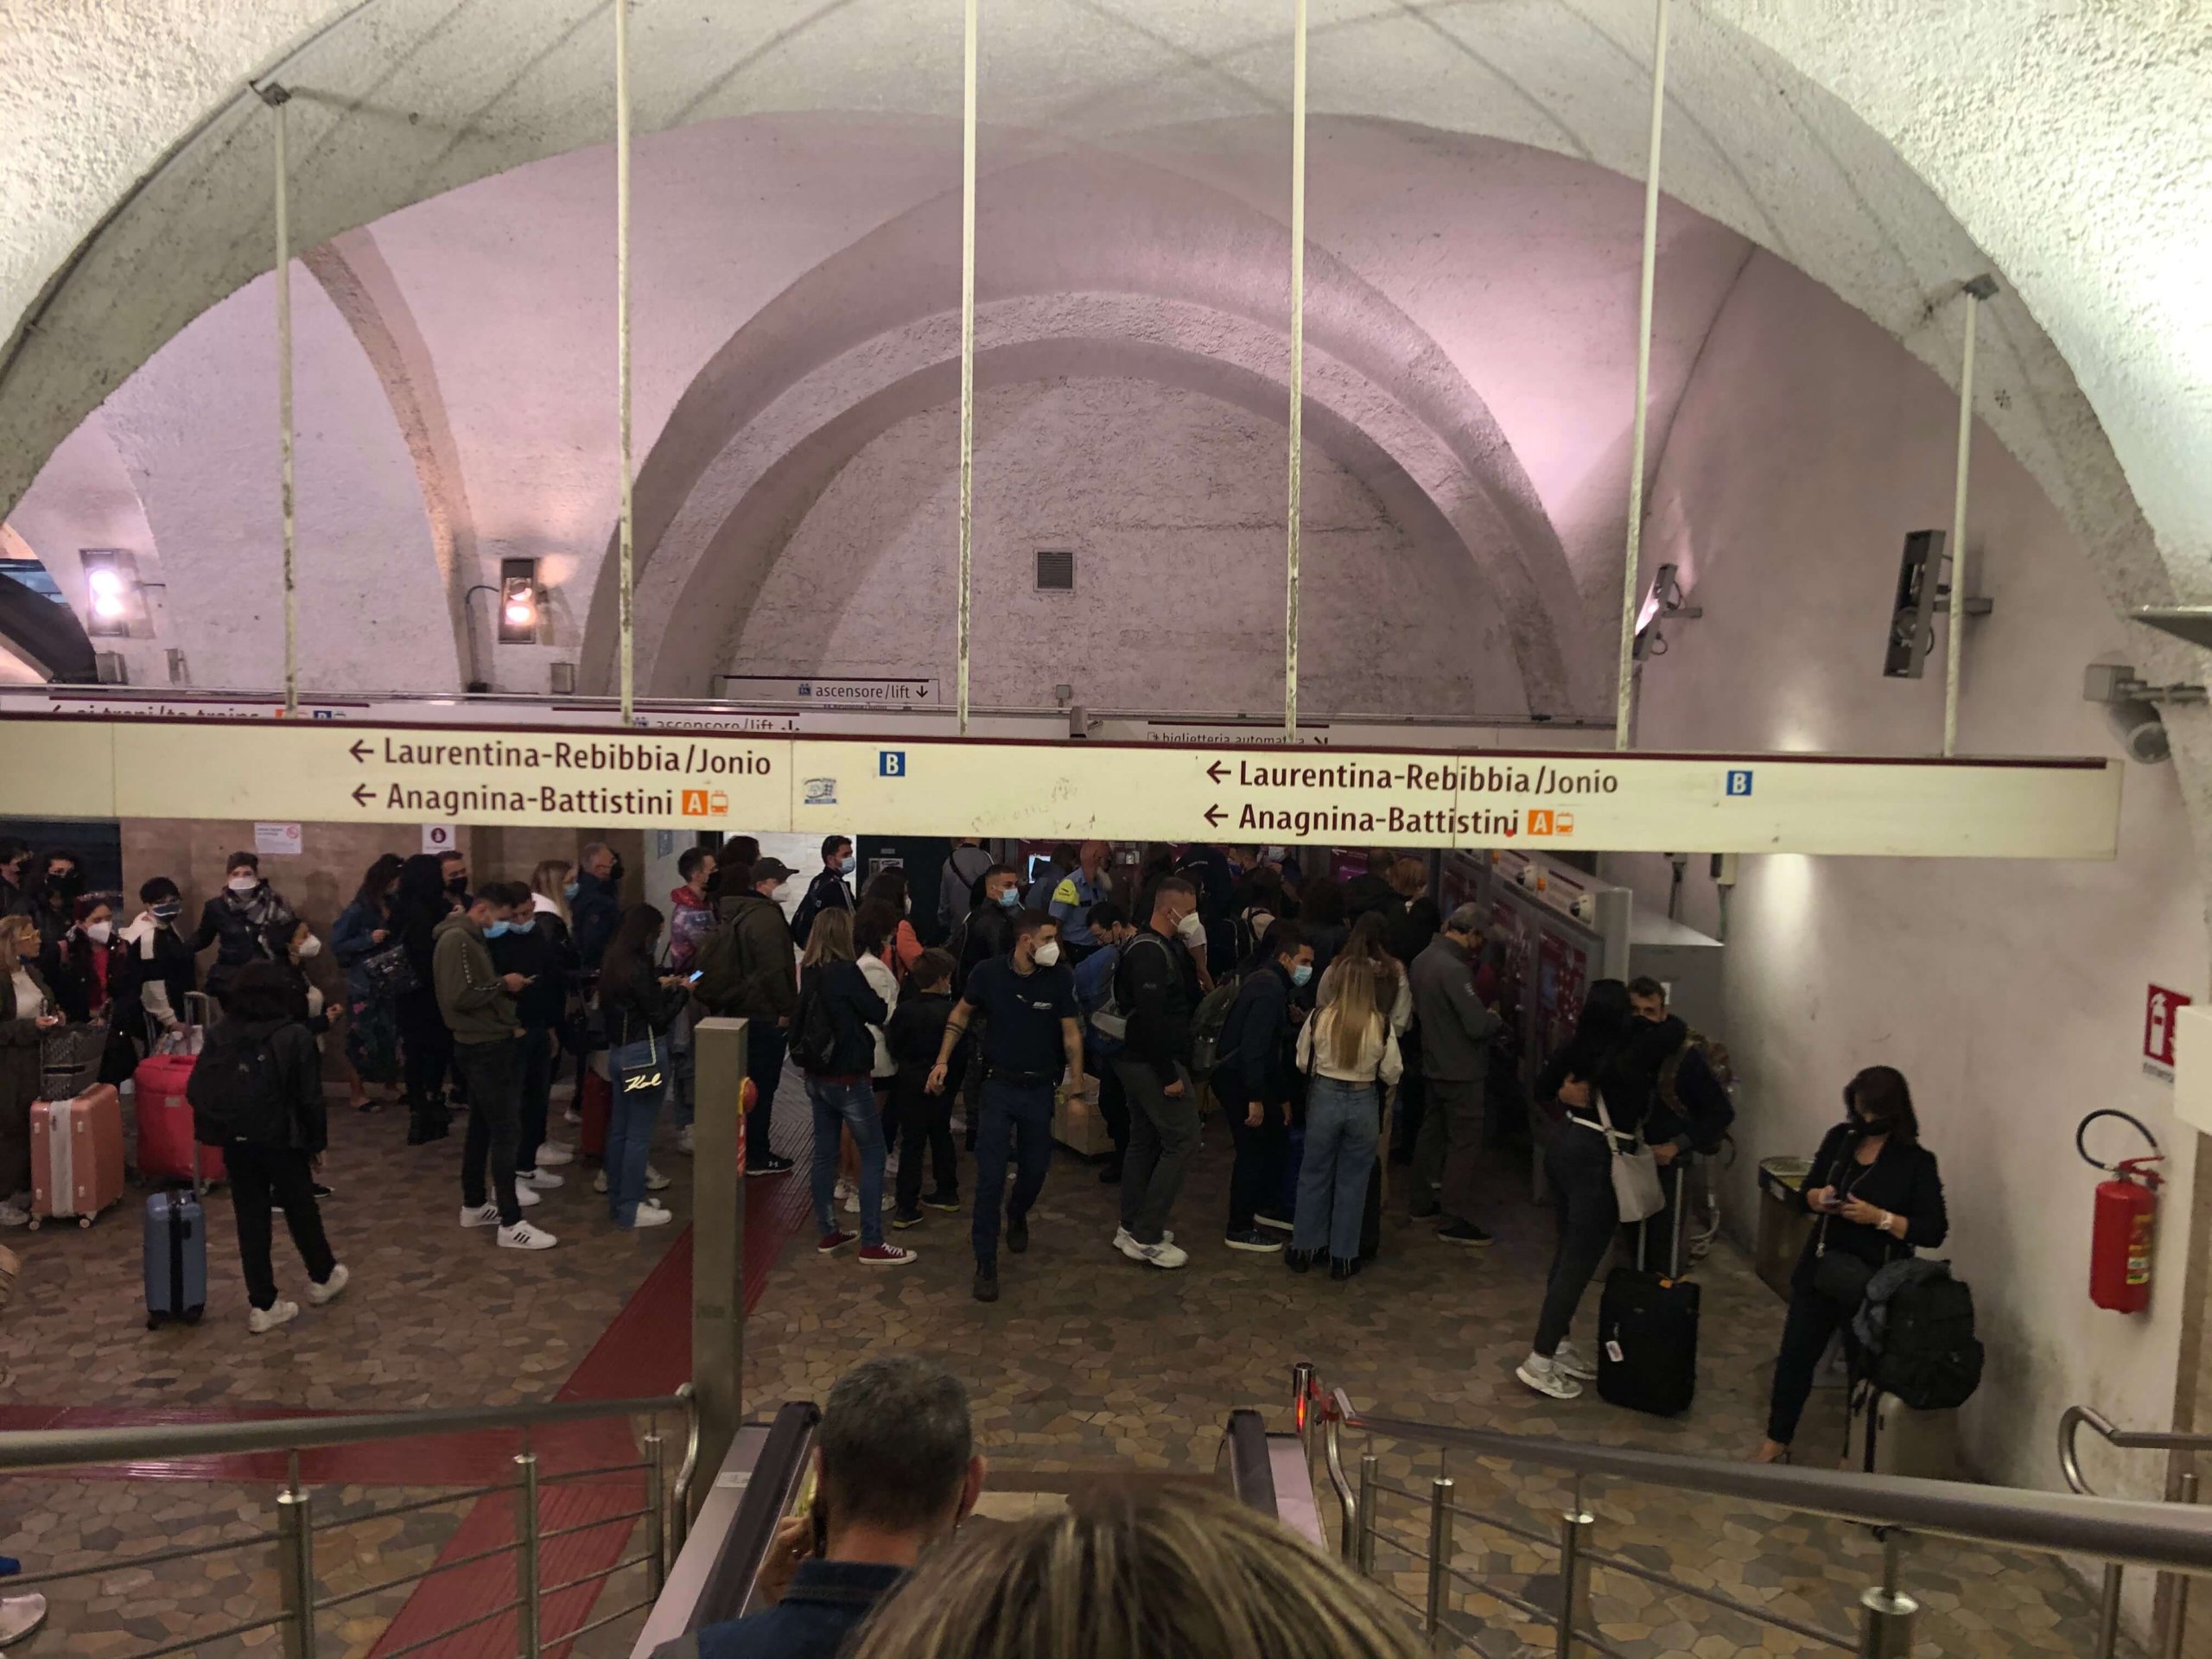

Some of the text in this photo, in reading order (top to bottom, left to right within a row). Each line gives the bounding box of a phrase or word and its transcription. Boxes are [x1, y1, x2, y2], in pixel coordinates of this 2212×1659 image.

[815, 684, 910, 700] ascensore/lift
[385, 737, 900, 776] Laurentina-Rebibbia/Jonio B
[1240, 760, 1750, 794] Laurentina-Rebibbia/Jonio B
[387, 782, 704, 817] Anagnina-Battistini A
[1239, 804, 1549, 836] Anagnina-Battistini A
